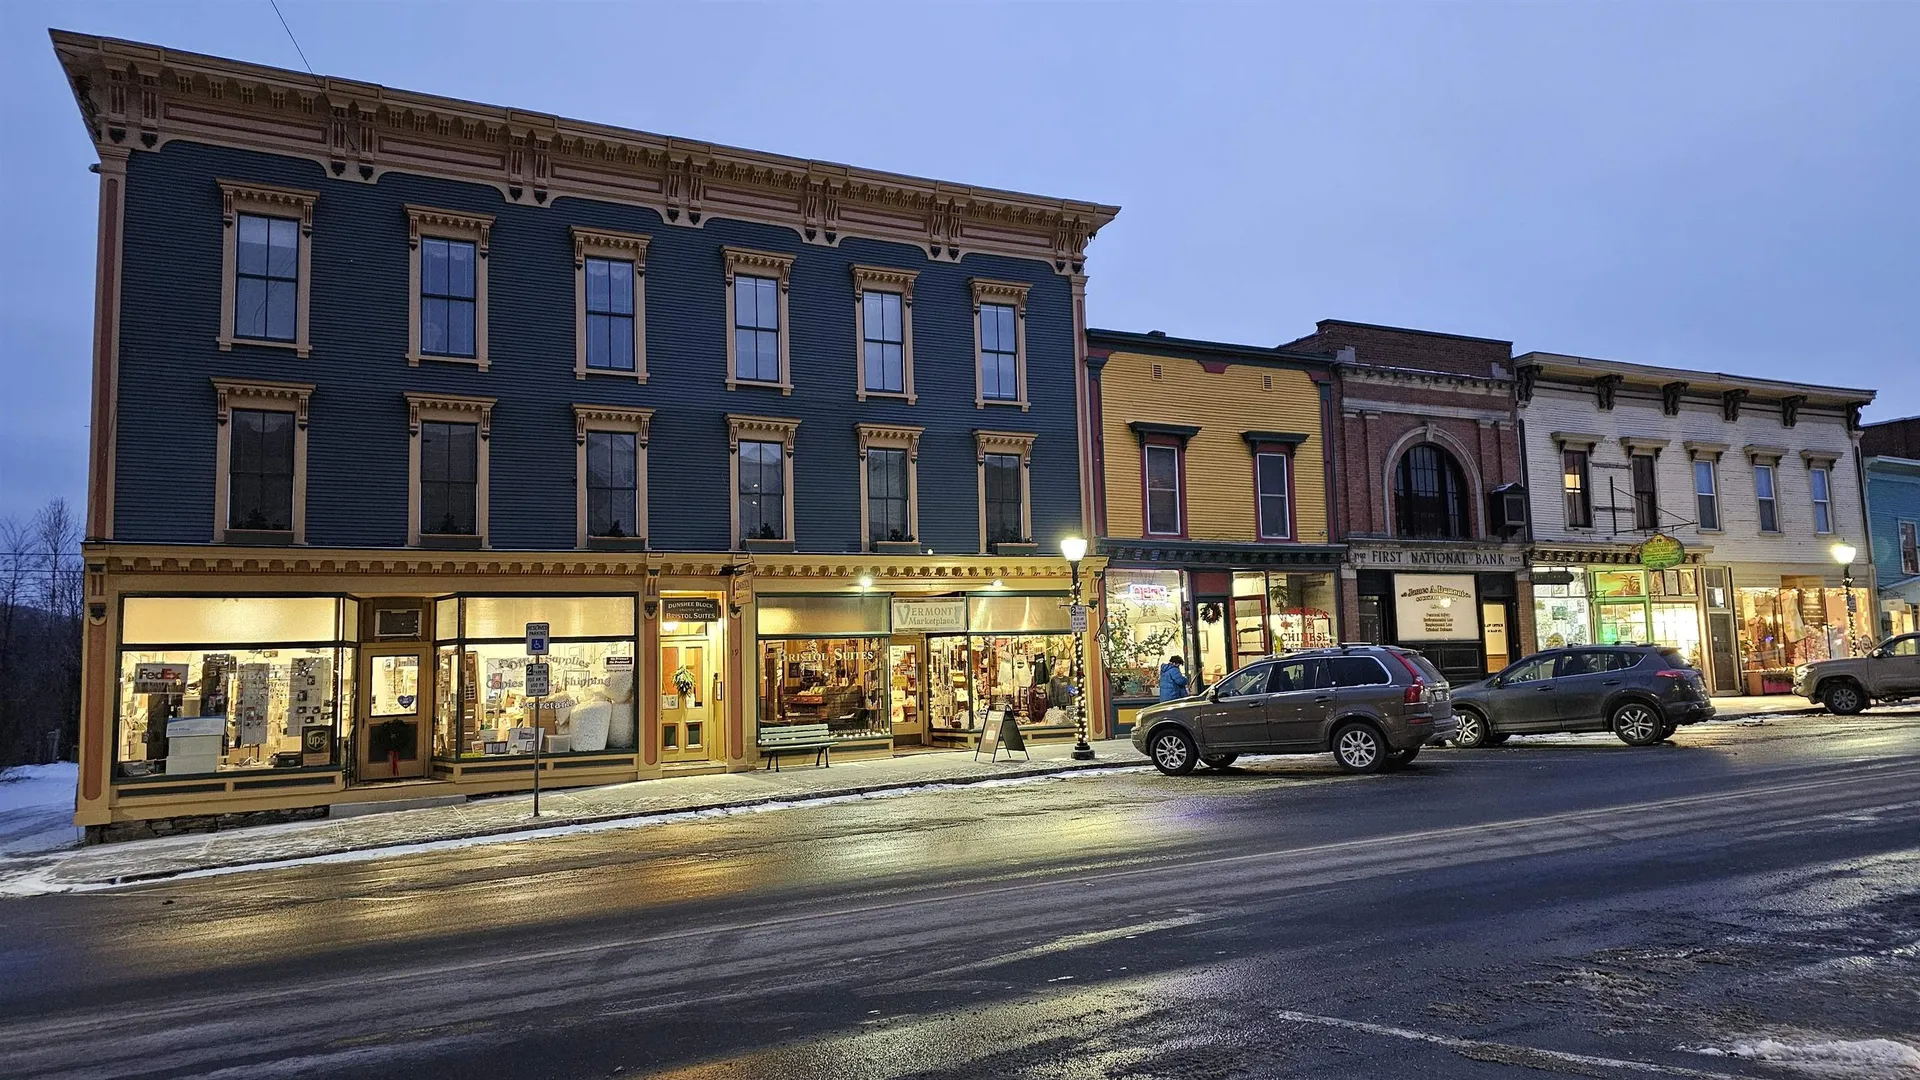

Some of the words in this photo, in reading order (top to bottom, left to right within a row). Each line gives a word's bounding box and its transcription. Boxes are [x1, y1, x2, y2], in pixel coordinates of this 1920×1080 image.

[1372, 551, 1403, 562] FIRST
[1411, 552, 1469, 564] NATIONAL
[1476, 553, 1505, 565] BANK
[668, 601, 695, 609] DUNSHEE
[695, 601, 714, 609] BLOCK
[895, 603, 954, 625] VERMONT
[908, 617, 955, 626] Marketplace
[1280, 632, 1329, 642] CHINESE
[779, 649, 829, 662] BRISTOL
[834, 647, 874, 661] SUITES
[139, 668, 181, 680] FedEx
[527, 665, 533, 674] 2
[486, 679, 524, 689] Copies
[309, 736, 325, 748] ups
